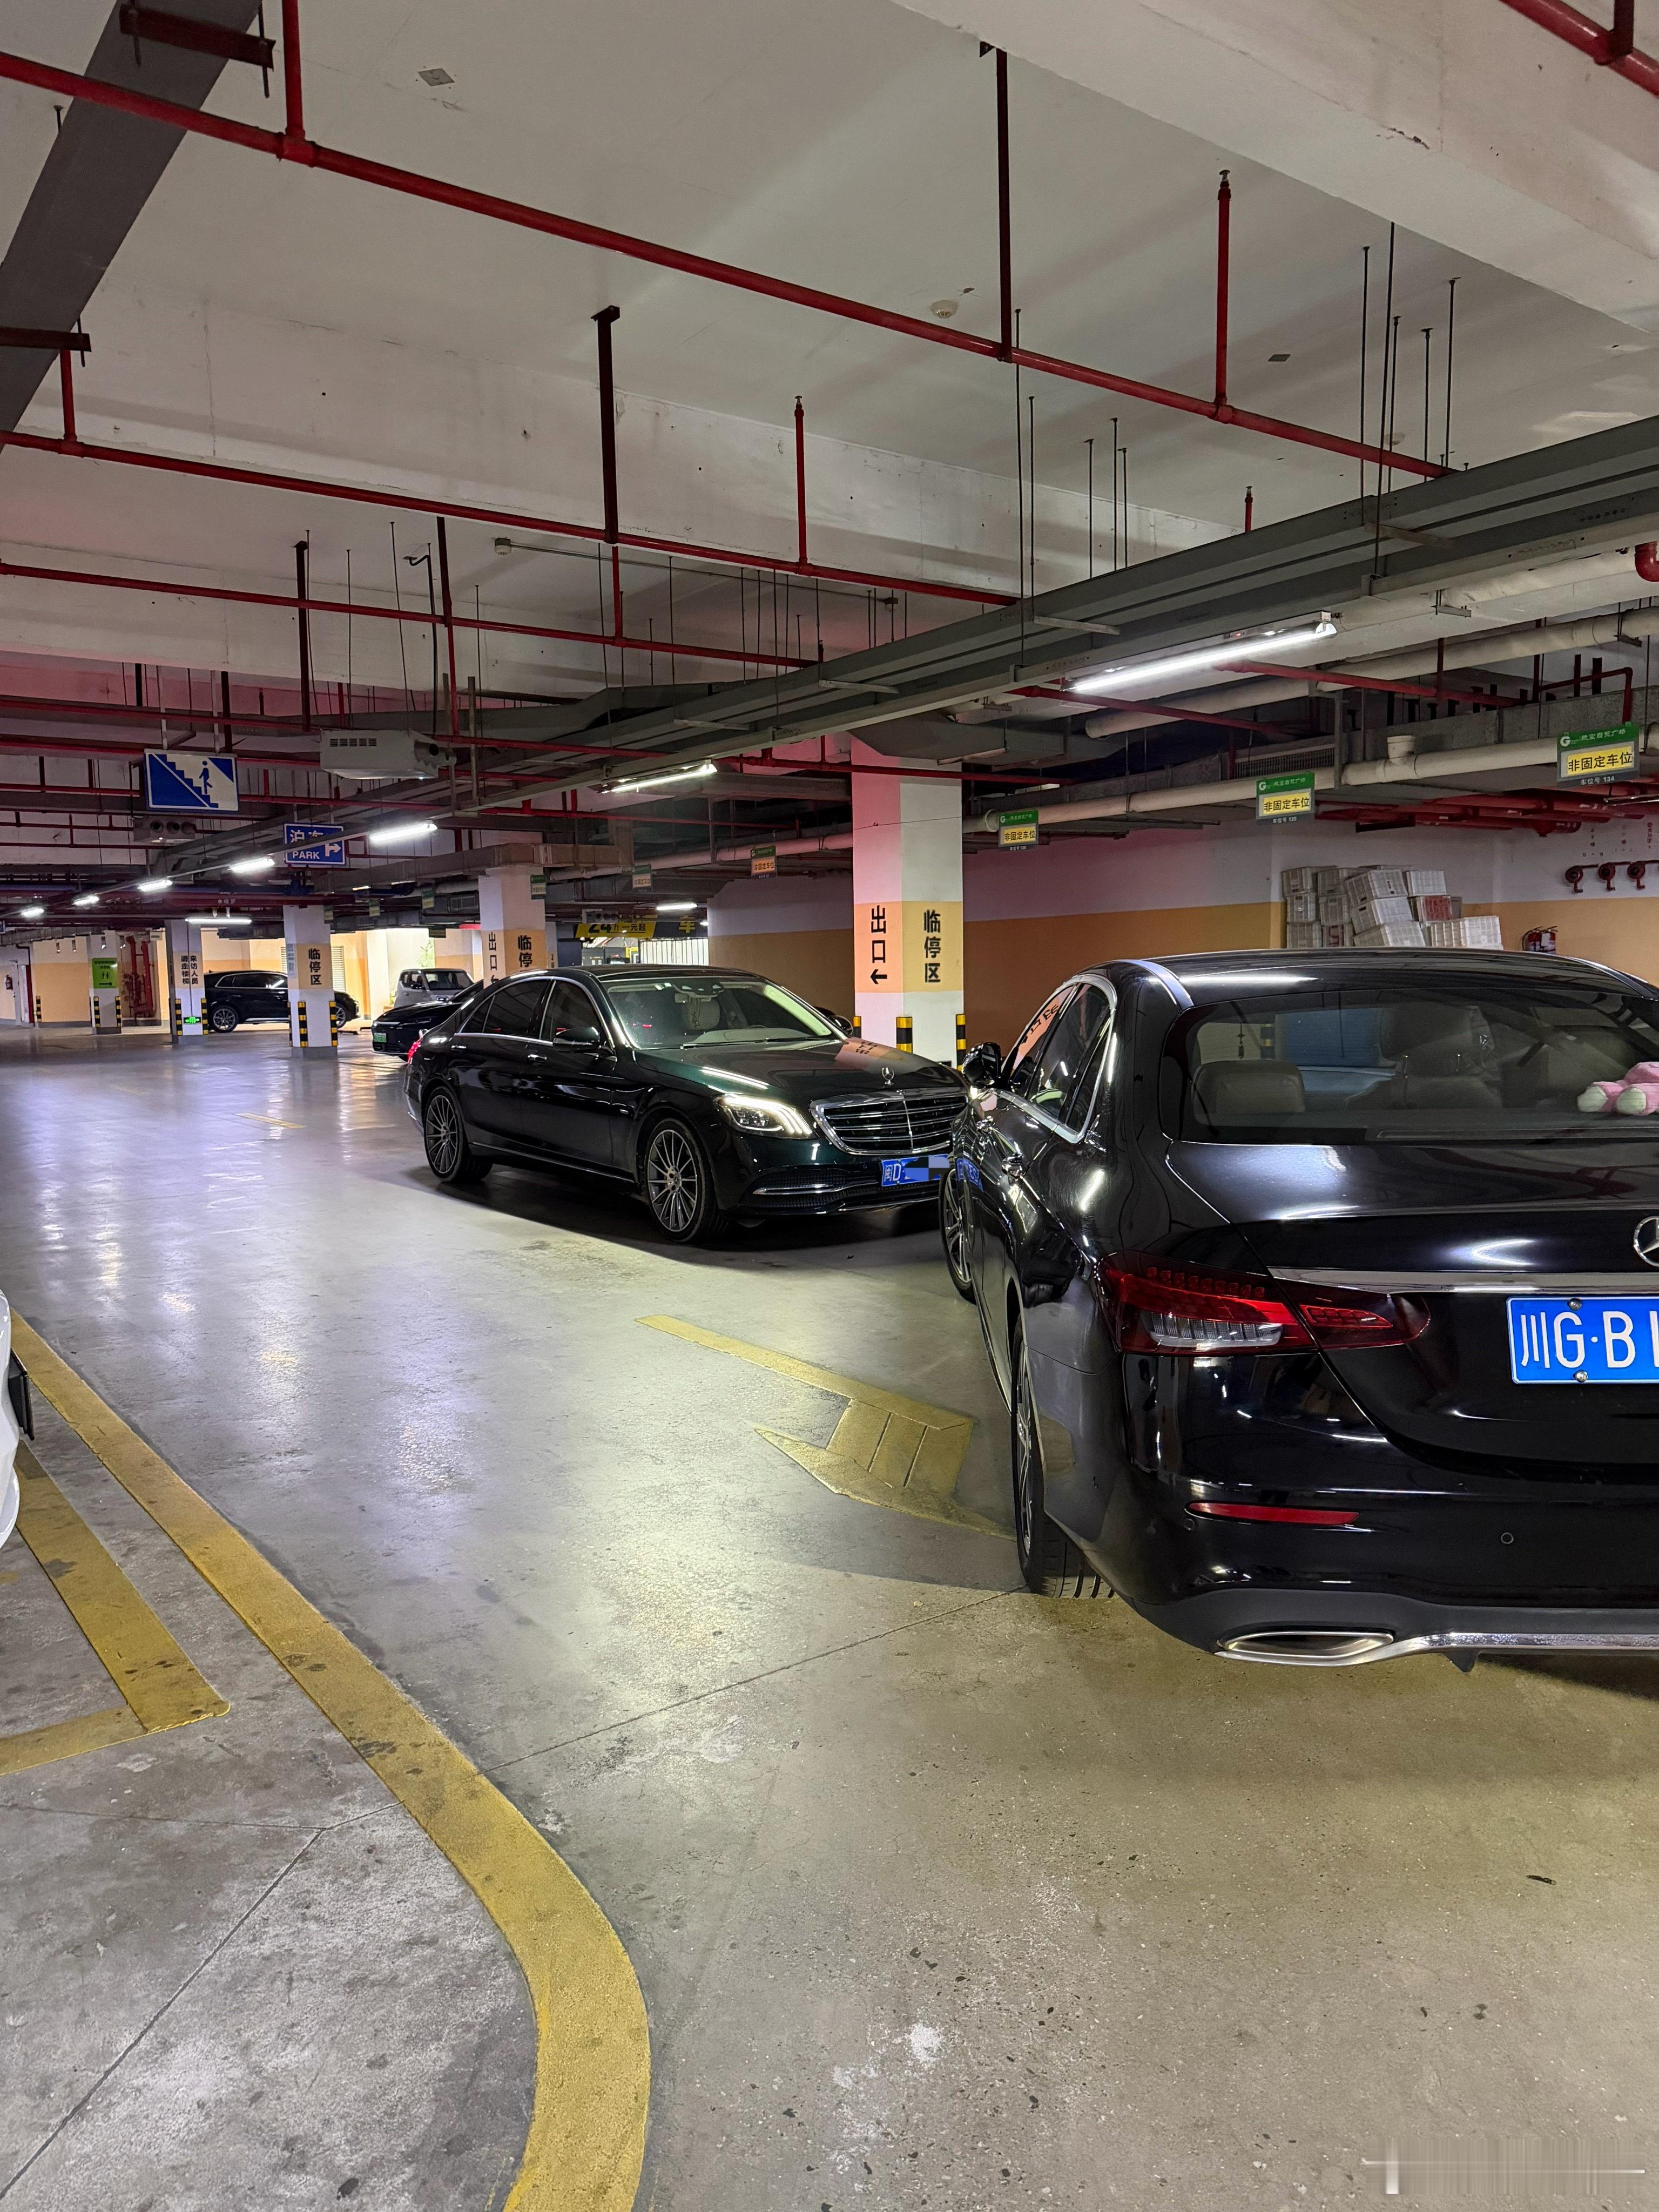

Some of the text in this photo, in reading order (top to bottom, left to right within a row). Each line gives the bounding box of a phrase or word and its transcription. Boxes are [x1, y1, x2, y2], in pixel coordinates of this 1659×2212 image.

[1568, 752, 1633, 772] 非固定车位
[1264, 797, 1310, 811] 非固定车位
[1004, 830, 1036, 841] 非固定车位
[292, 851, 320, 860] PARK
[871, 905, 886, 963] 出口
[923, 909, 941, 983] 临停区
[308, 948, 322, 985] 临停区
[488, 932, 497, 970] 出口
[517, 935, 532, 972] 临停
[190, 955, 198, 984] 来访人员
